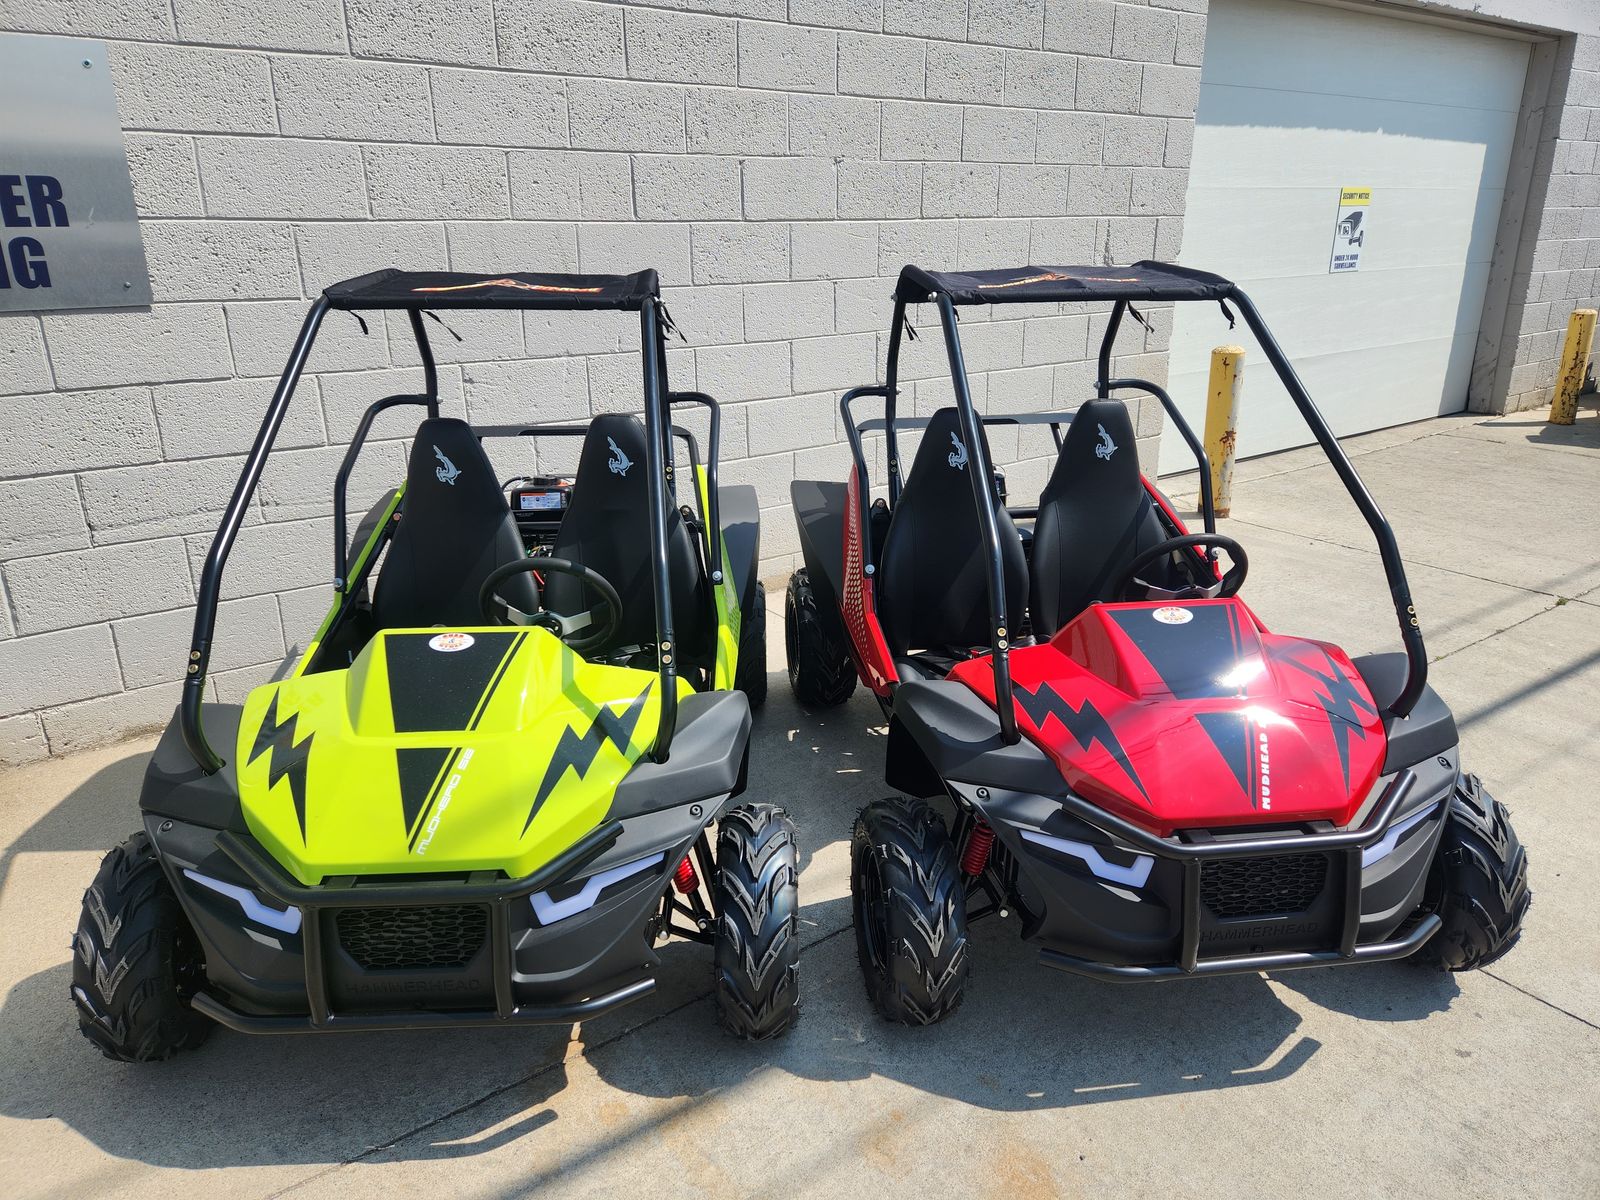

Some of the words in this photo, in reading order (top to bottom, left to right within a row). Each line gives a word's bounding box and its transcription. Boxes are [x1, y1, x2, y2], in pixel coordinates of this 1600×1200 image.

[1342, 192, 1358, 200] SECURITY
[1358, 192, 1370, 200] NOTICE
[1259, 732, 1271, 811] MUDHEAD
[1200, 922, 1319, 943] HAMMERHEAD
[344, 978, 481, 994] HAMMERHEAD
